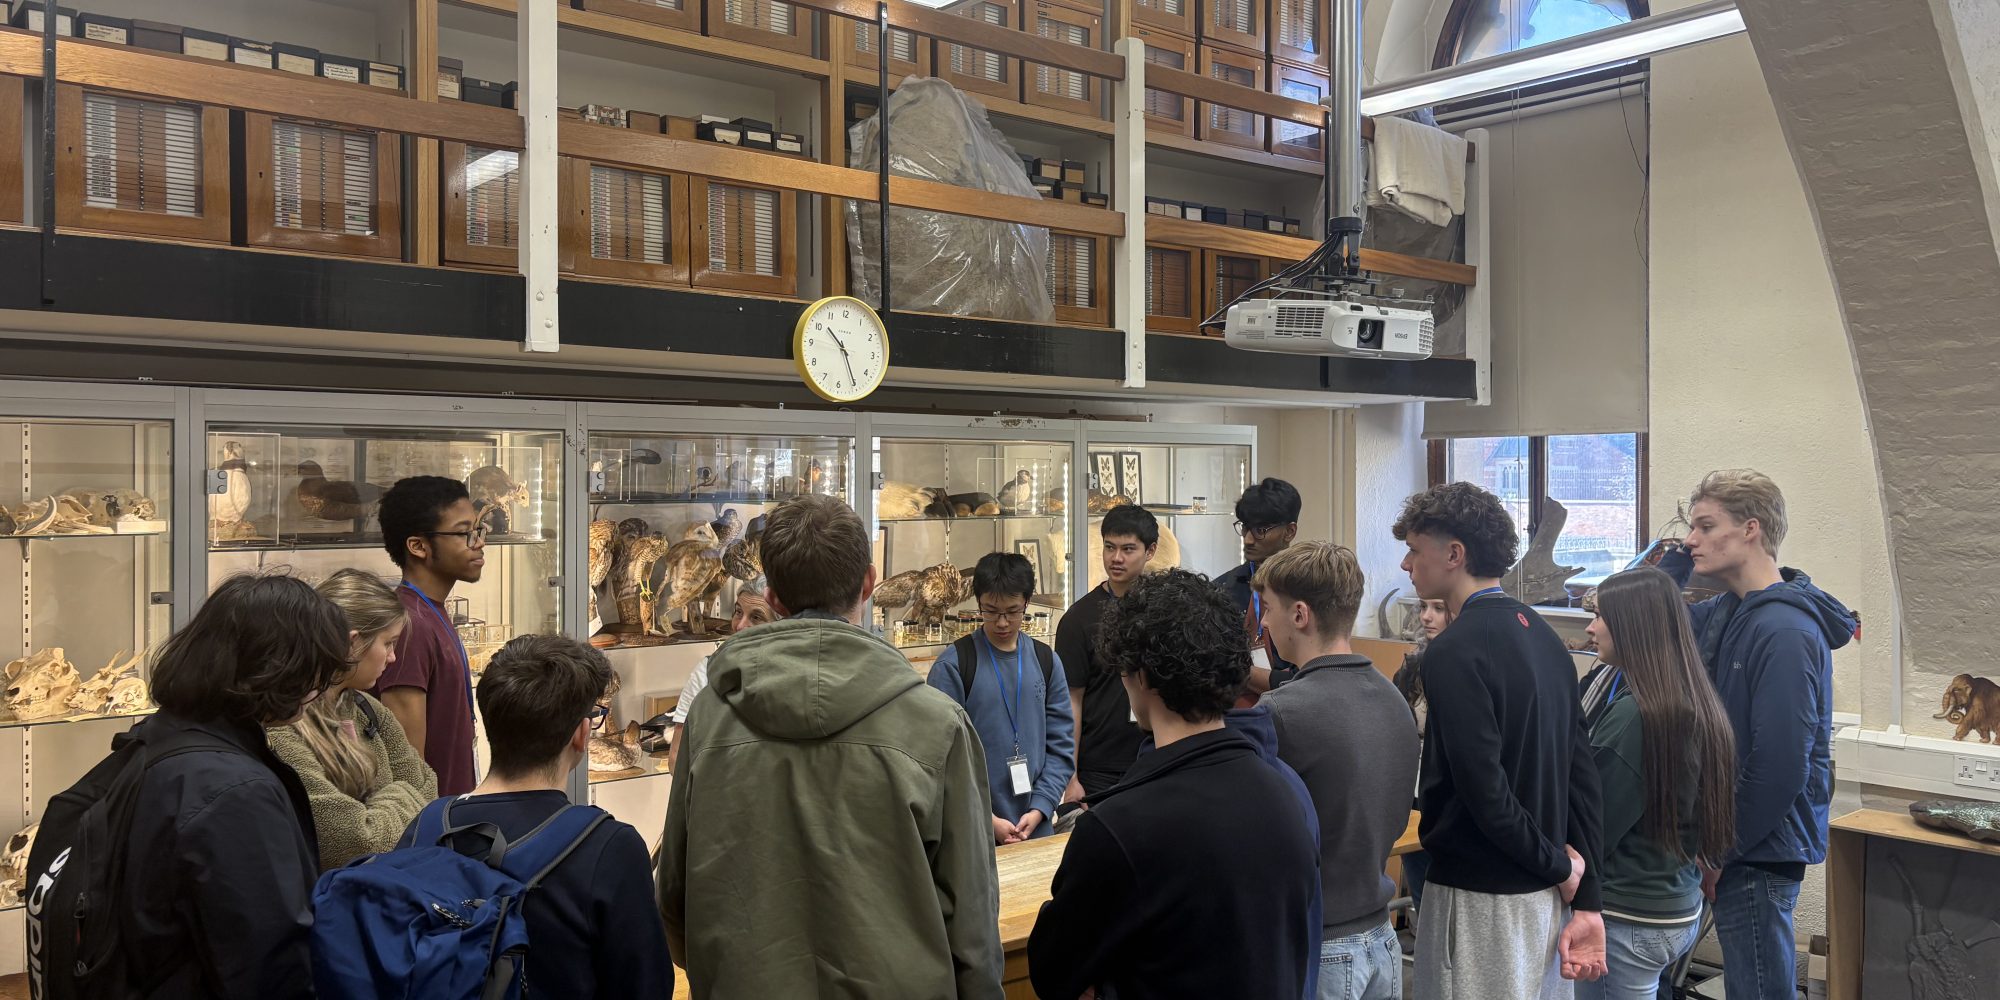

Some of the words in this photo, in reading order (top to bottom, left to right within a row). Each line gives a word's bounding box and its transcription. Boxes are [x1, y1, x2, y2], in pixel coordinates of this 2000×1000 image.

[828, 311, 834, 320] 11
[842, 309, 850, 319] 12
[815, 322, 823, 331] 10
[868, 333, 873, 341] 2
[808, 338, 814, 346] 9
[870, 352, 875, 360] 3
[811, 357, 817, 366] 8
[822, 372, 828, 381] 7
[863, 369, 869, 377] 4
[836, 380, 841, 389] 6
[27, 846, 72, 1000] didas
